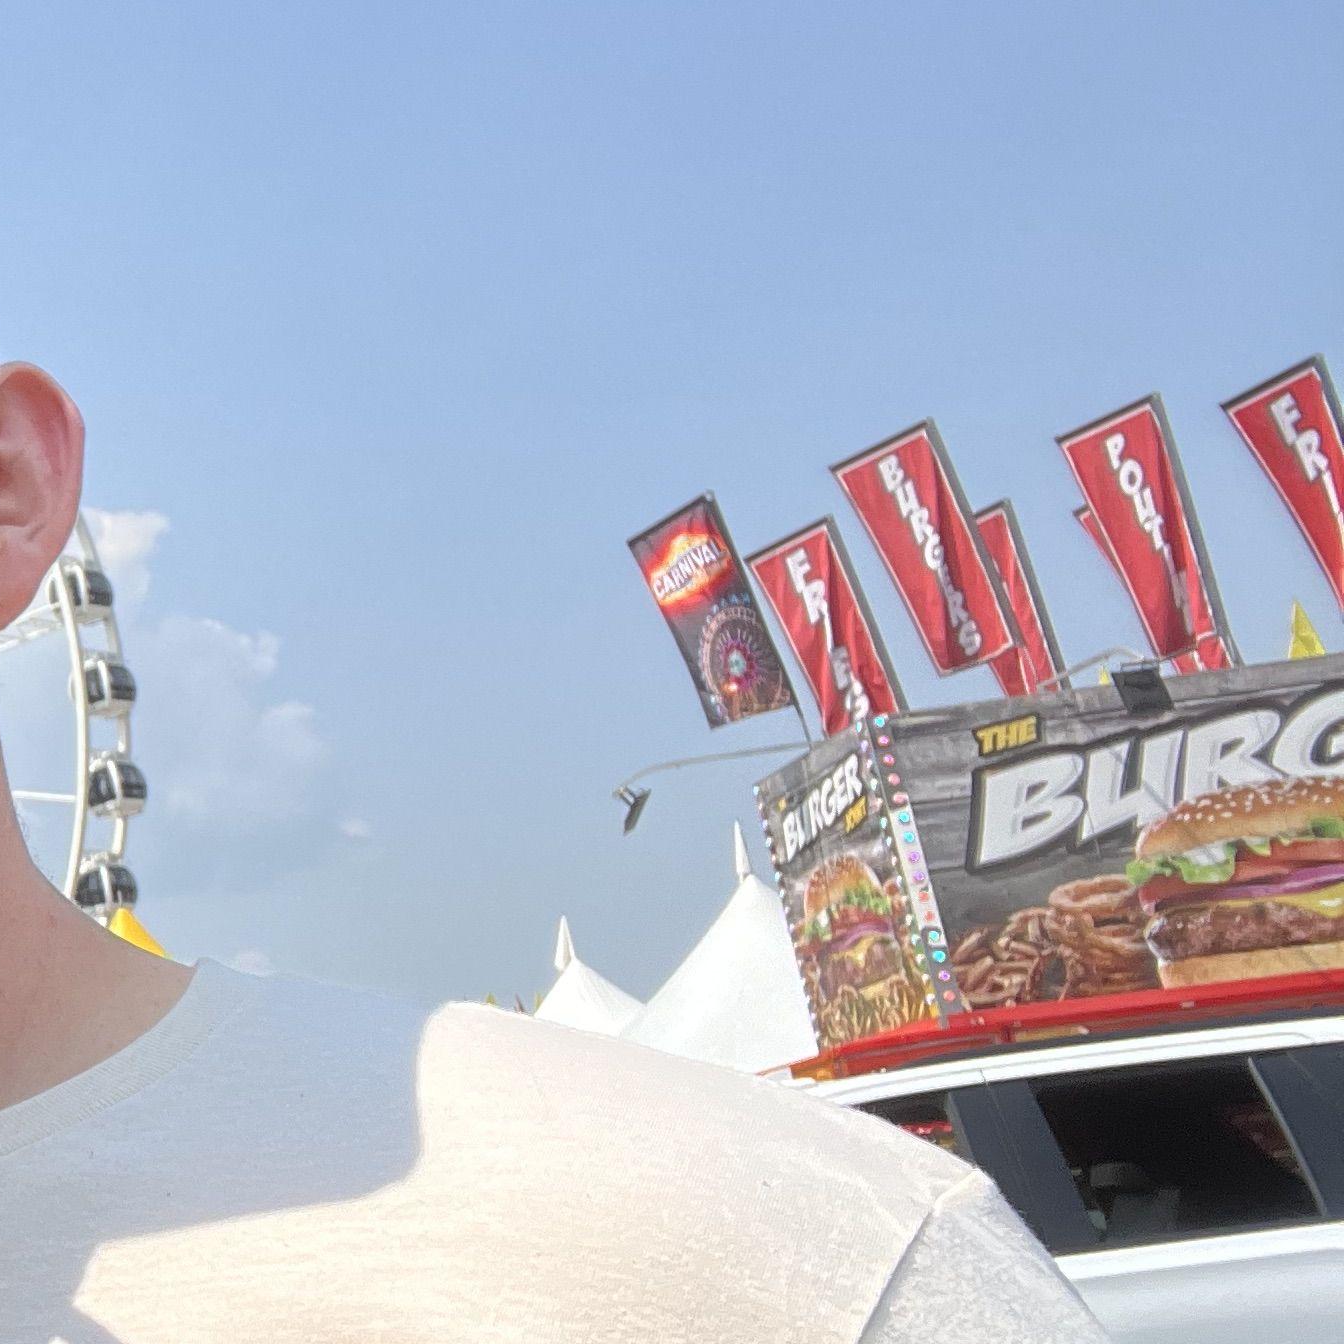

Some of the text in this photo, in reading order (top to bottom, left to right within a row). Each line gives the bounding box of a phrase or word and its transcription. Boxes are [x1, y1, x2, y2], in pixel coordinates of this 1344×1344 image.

[1270, 393, 1344, 561] FRI
[976, 715, 1037, 755] THE
[783, 753, 863, 860] BURGER
